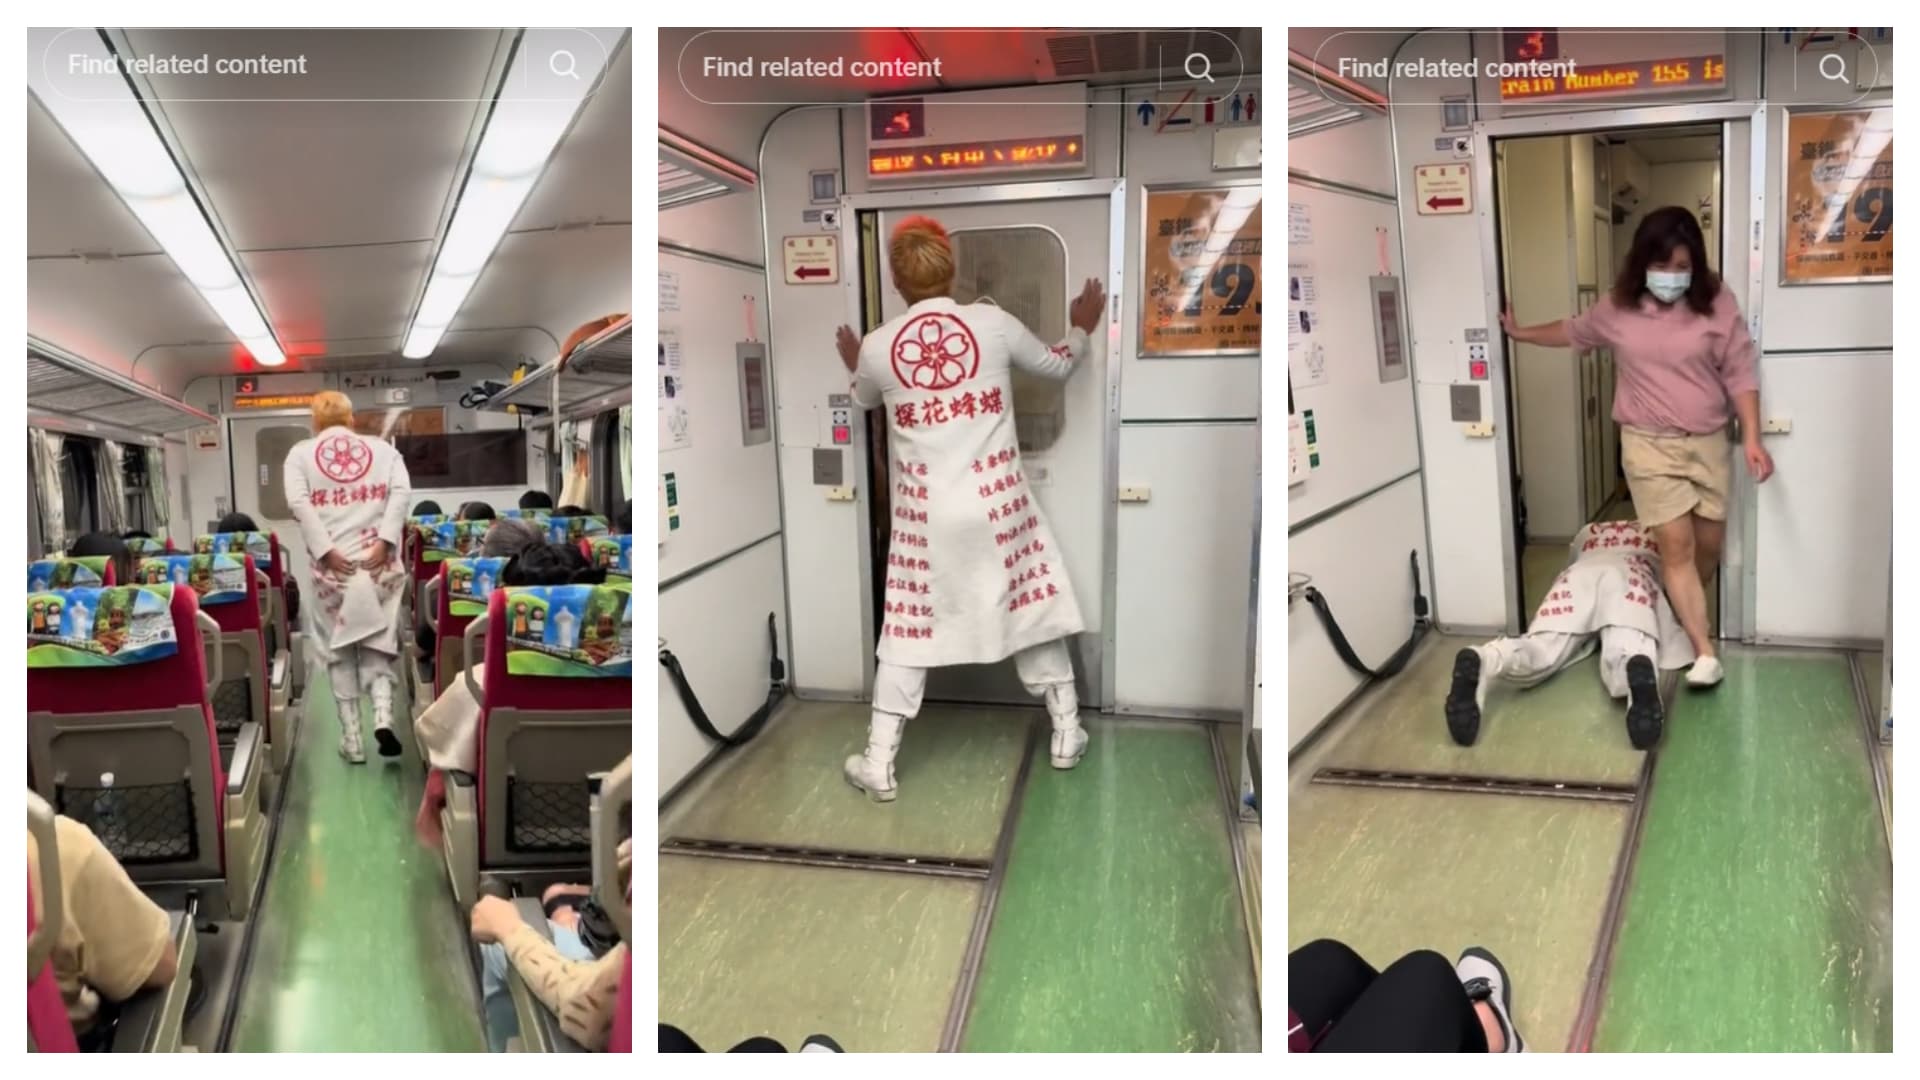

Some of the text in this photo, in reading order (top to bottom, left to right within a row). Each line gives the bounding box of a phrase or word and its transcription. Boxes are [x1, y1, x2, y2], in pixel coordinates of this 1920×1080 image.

[1652, 63, 1690, 84] 155
[895, 387, 1003, 428] 探花蜂蝶
